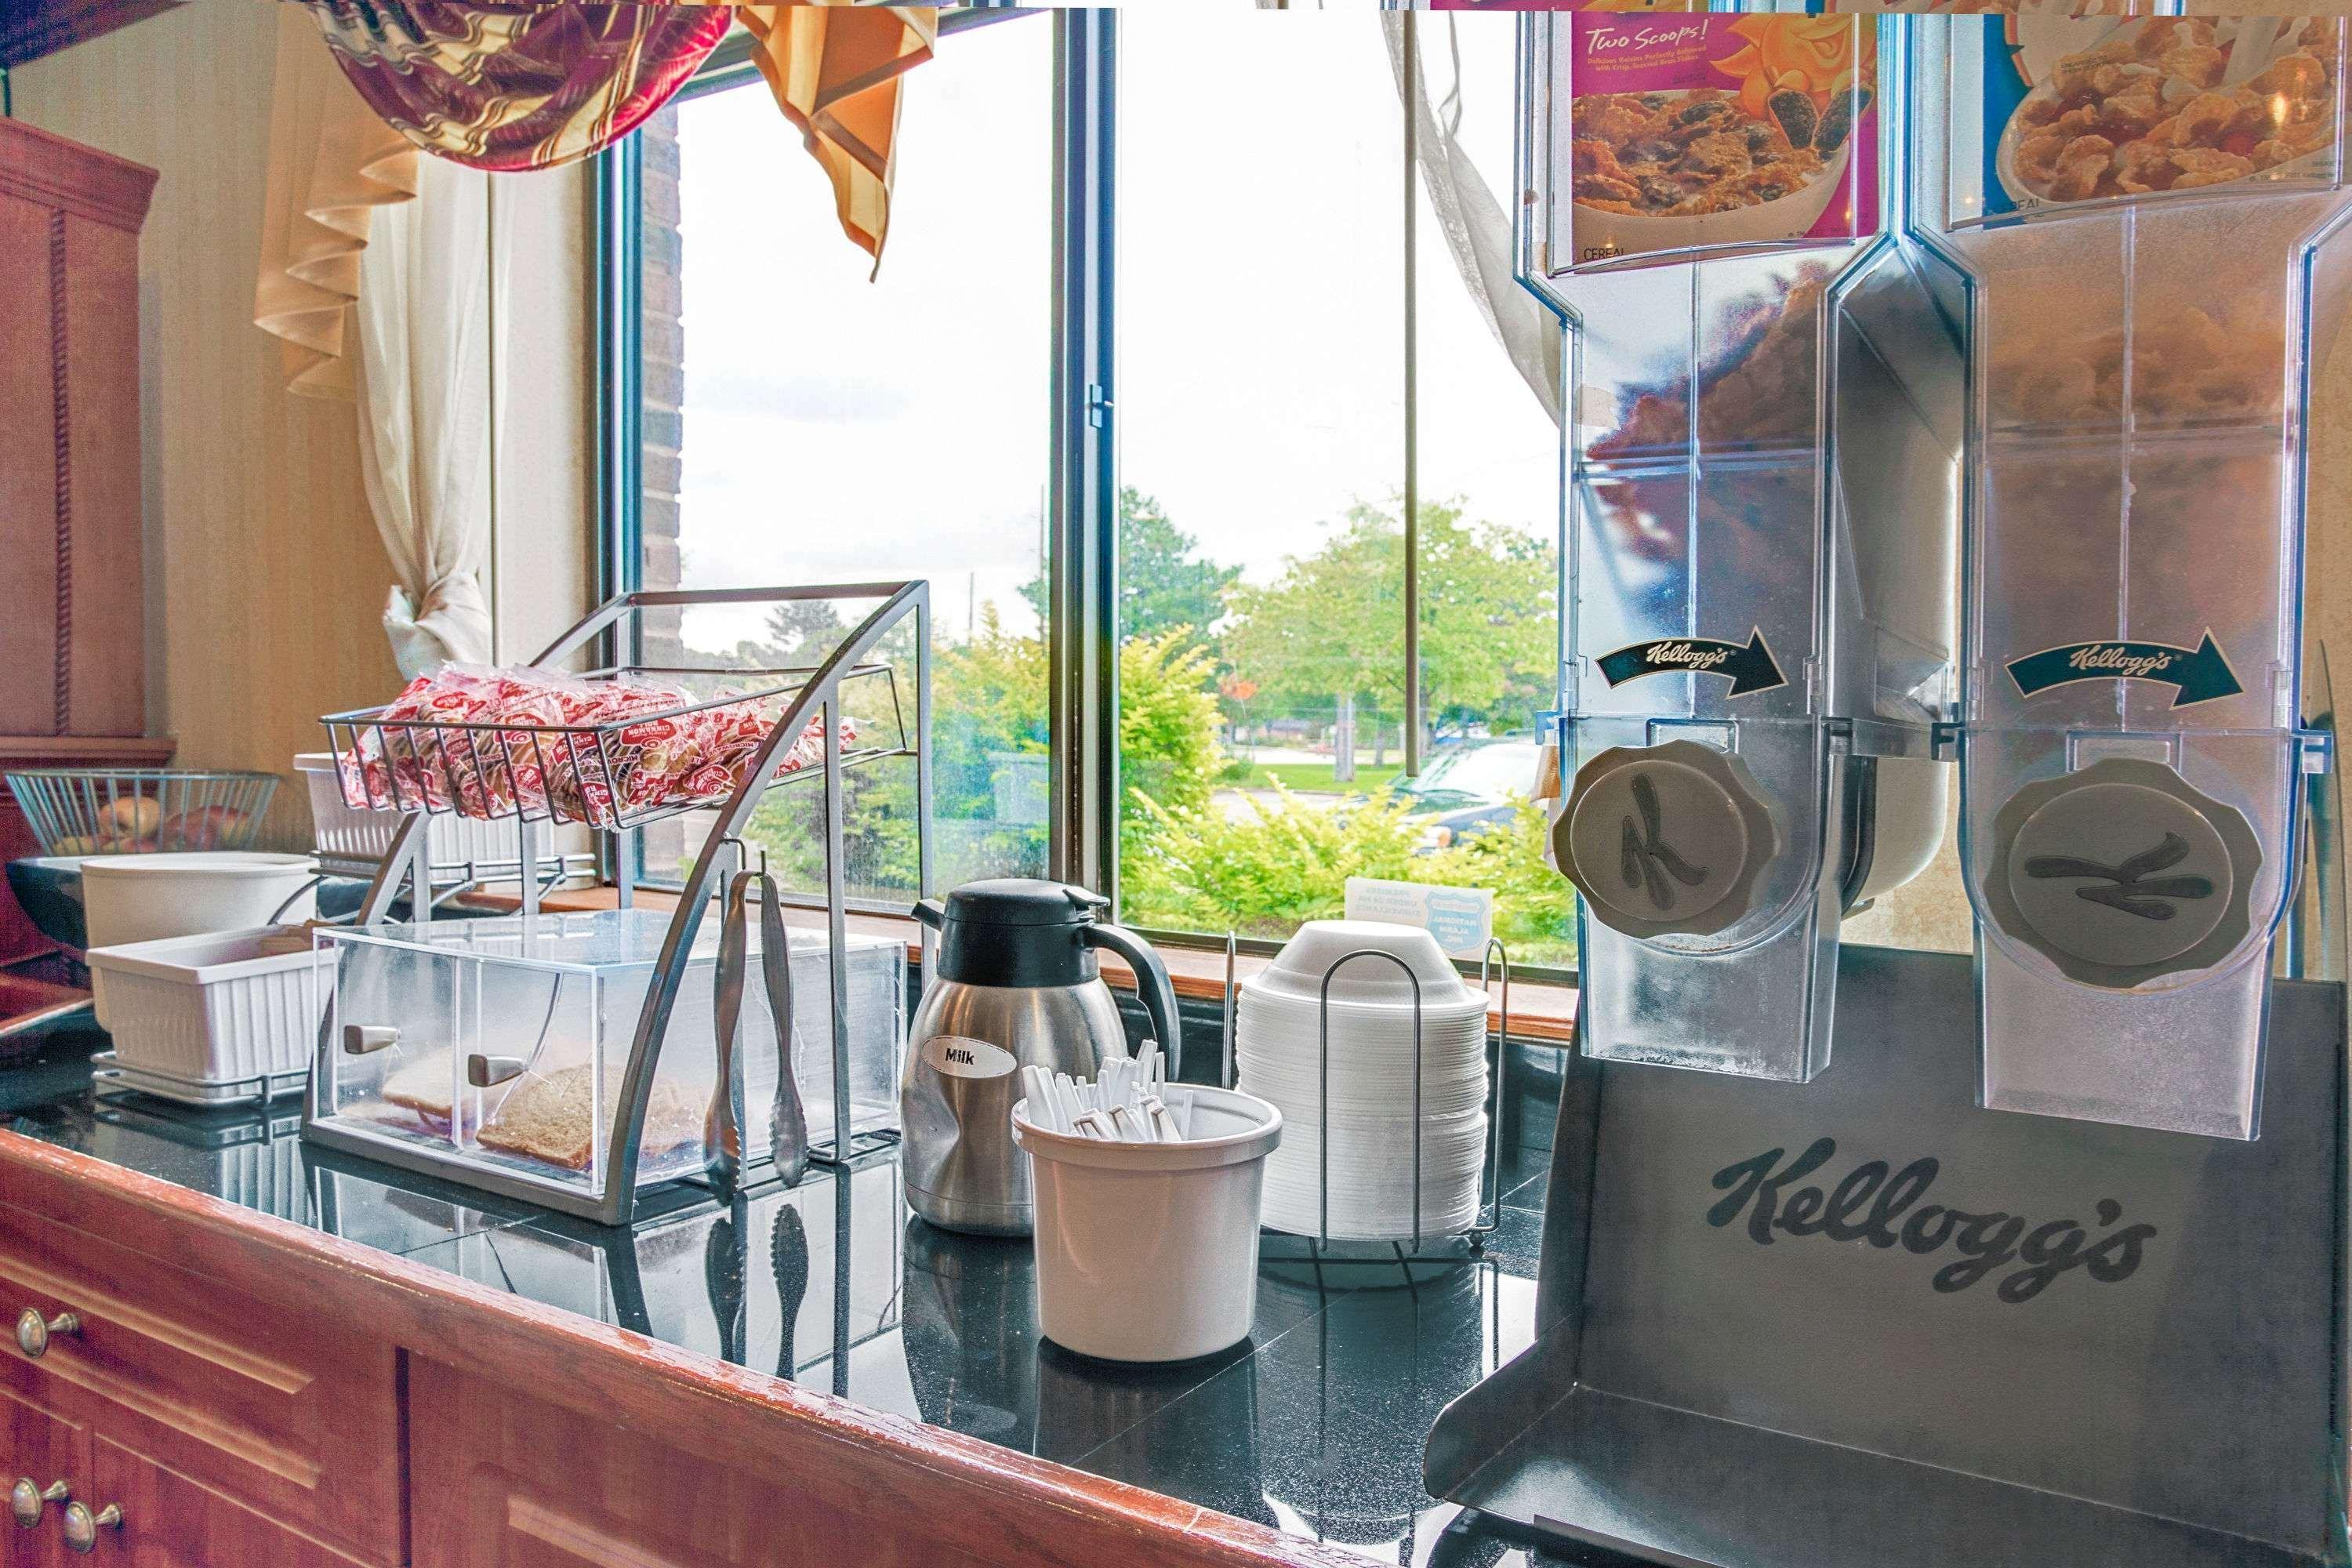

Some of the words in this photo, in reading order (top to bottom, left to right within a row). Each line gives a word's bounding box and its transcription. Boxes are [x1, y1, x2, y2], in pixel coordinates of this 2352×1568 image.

[1585, 27, 1630, 55] Two
[1635, 19, 1708, 50] Scoops!
[1646, 641, 1728, 669] Kellogg's
[2069, 644, 2172, 676] Kellogg's
[627, 724, 670, 736] CINNAMON
[946, 1047, 975, 1065] Milk
[1706, 1137, 2158, 1304] Kellogg's
